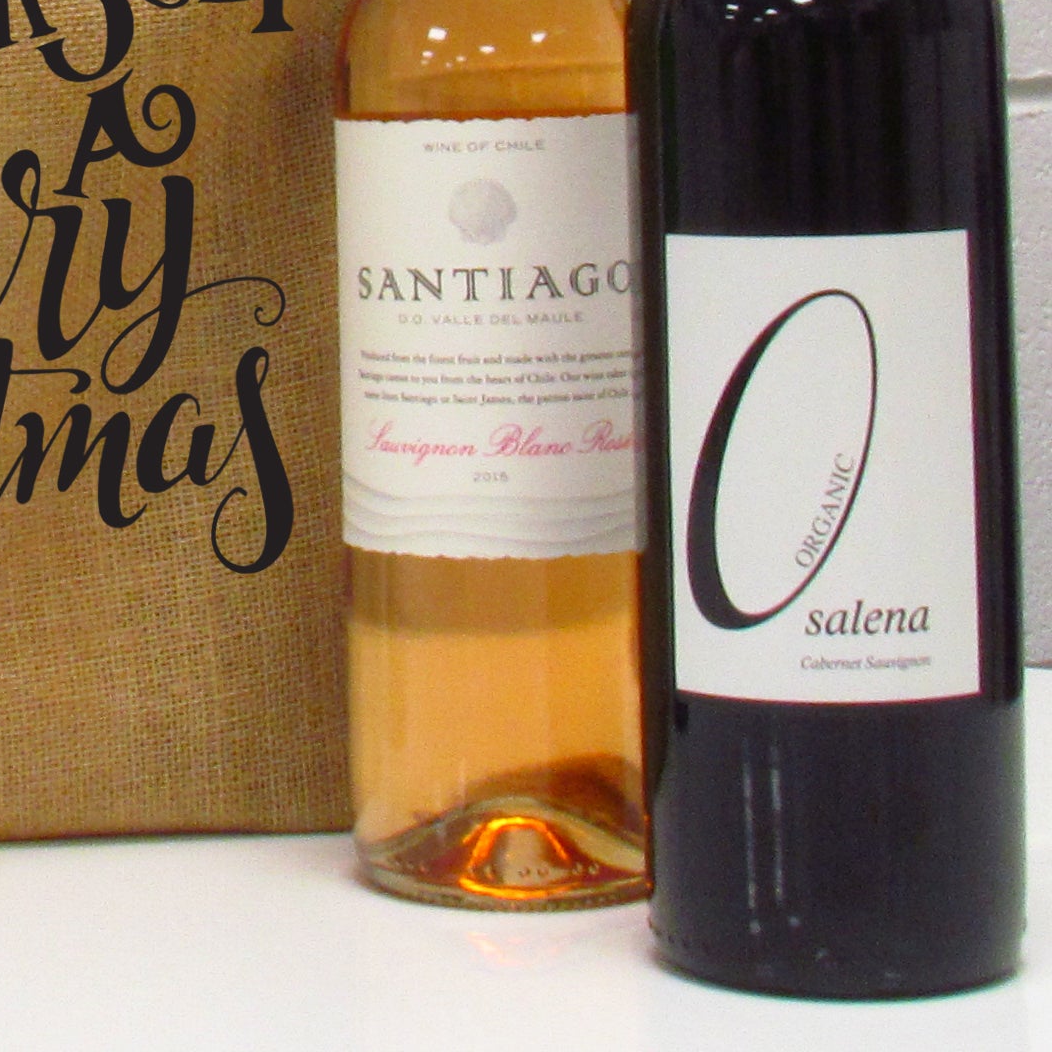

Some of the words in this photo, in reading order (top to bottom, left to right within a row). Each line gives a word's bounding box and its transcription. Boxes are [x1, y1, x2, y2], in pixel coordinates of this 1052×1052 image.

[54, 67, 197, 199] A
[357, 259, 632, 302] SANTIAGO
[432, 313, 482, 326] VALLE
[489, 313, 521, 325] DEL
[367, 419, 478, 466] Sauvignon
[482, 422, 572, 458] Blanc
[794, 453, 855, 569] ORGANIC
[804, 599, 930, 636] salena
[800, 654, 862, 670] Cabernet
